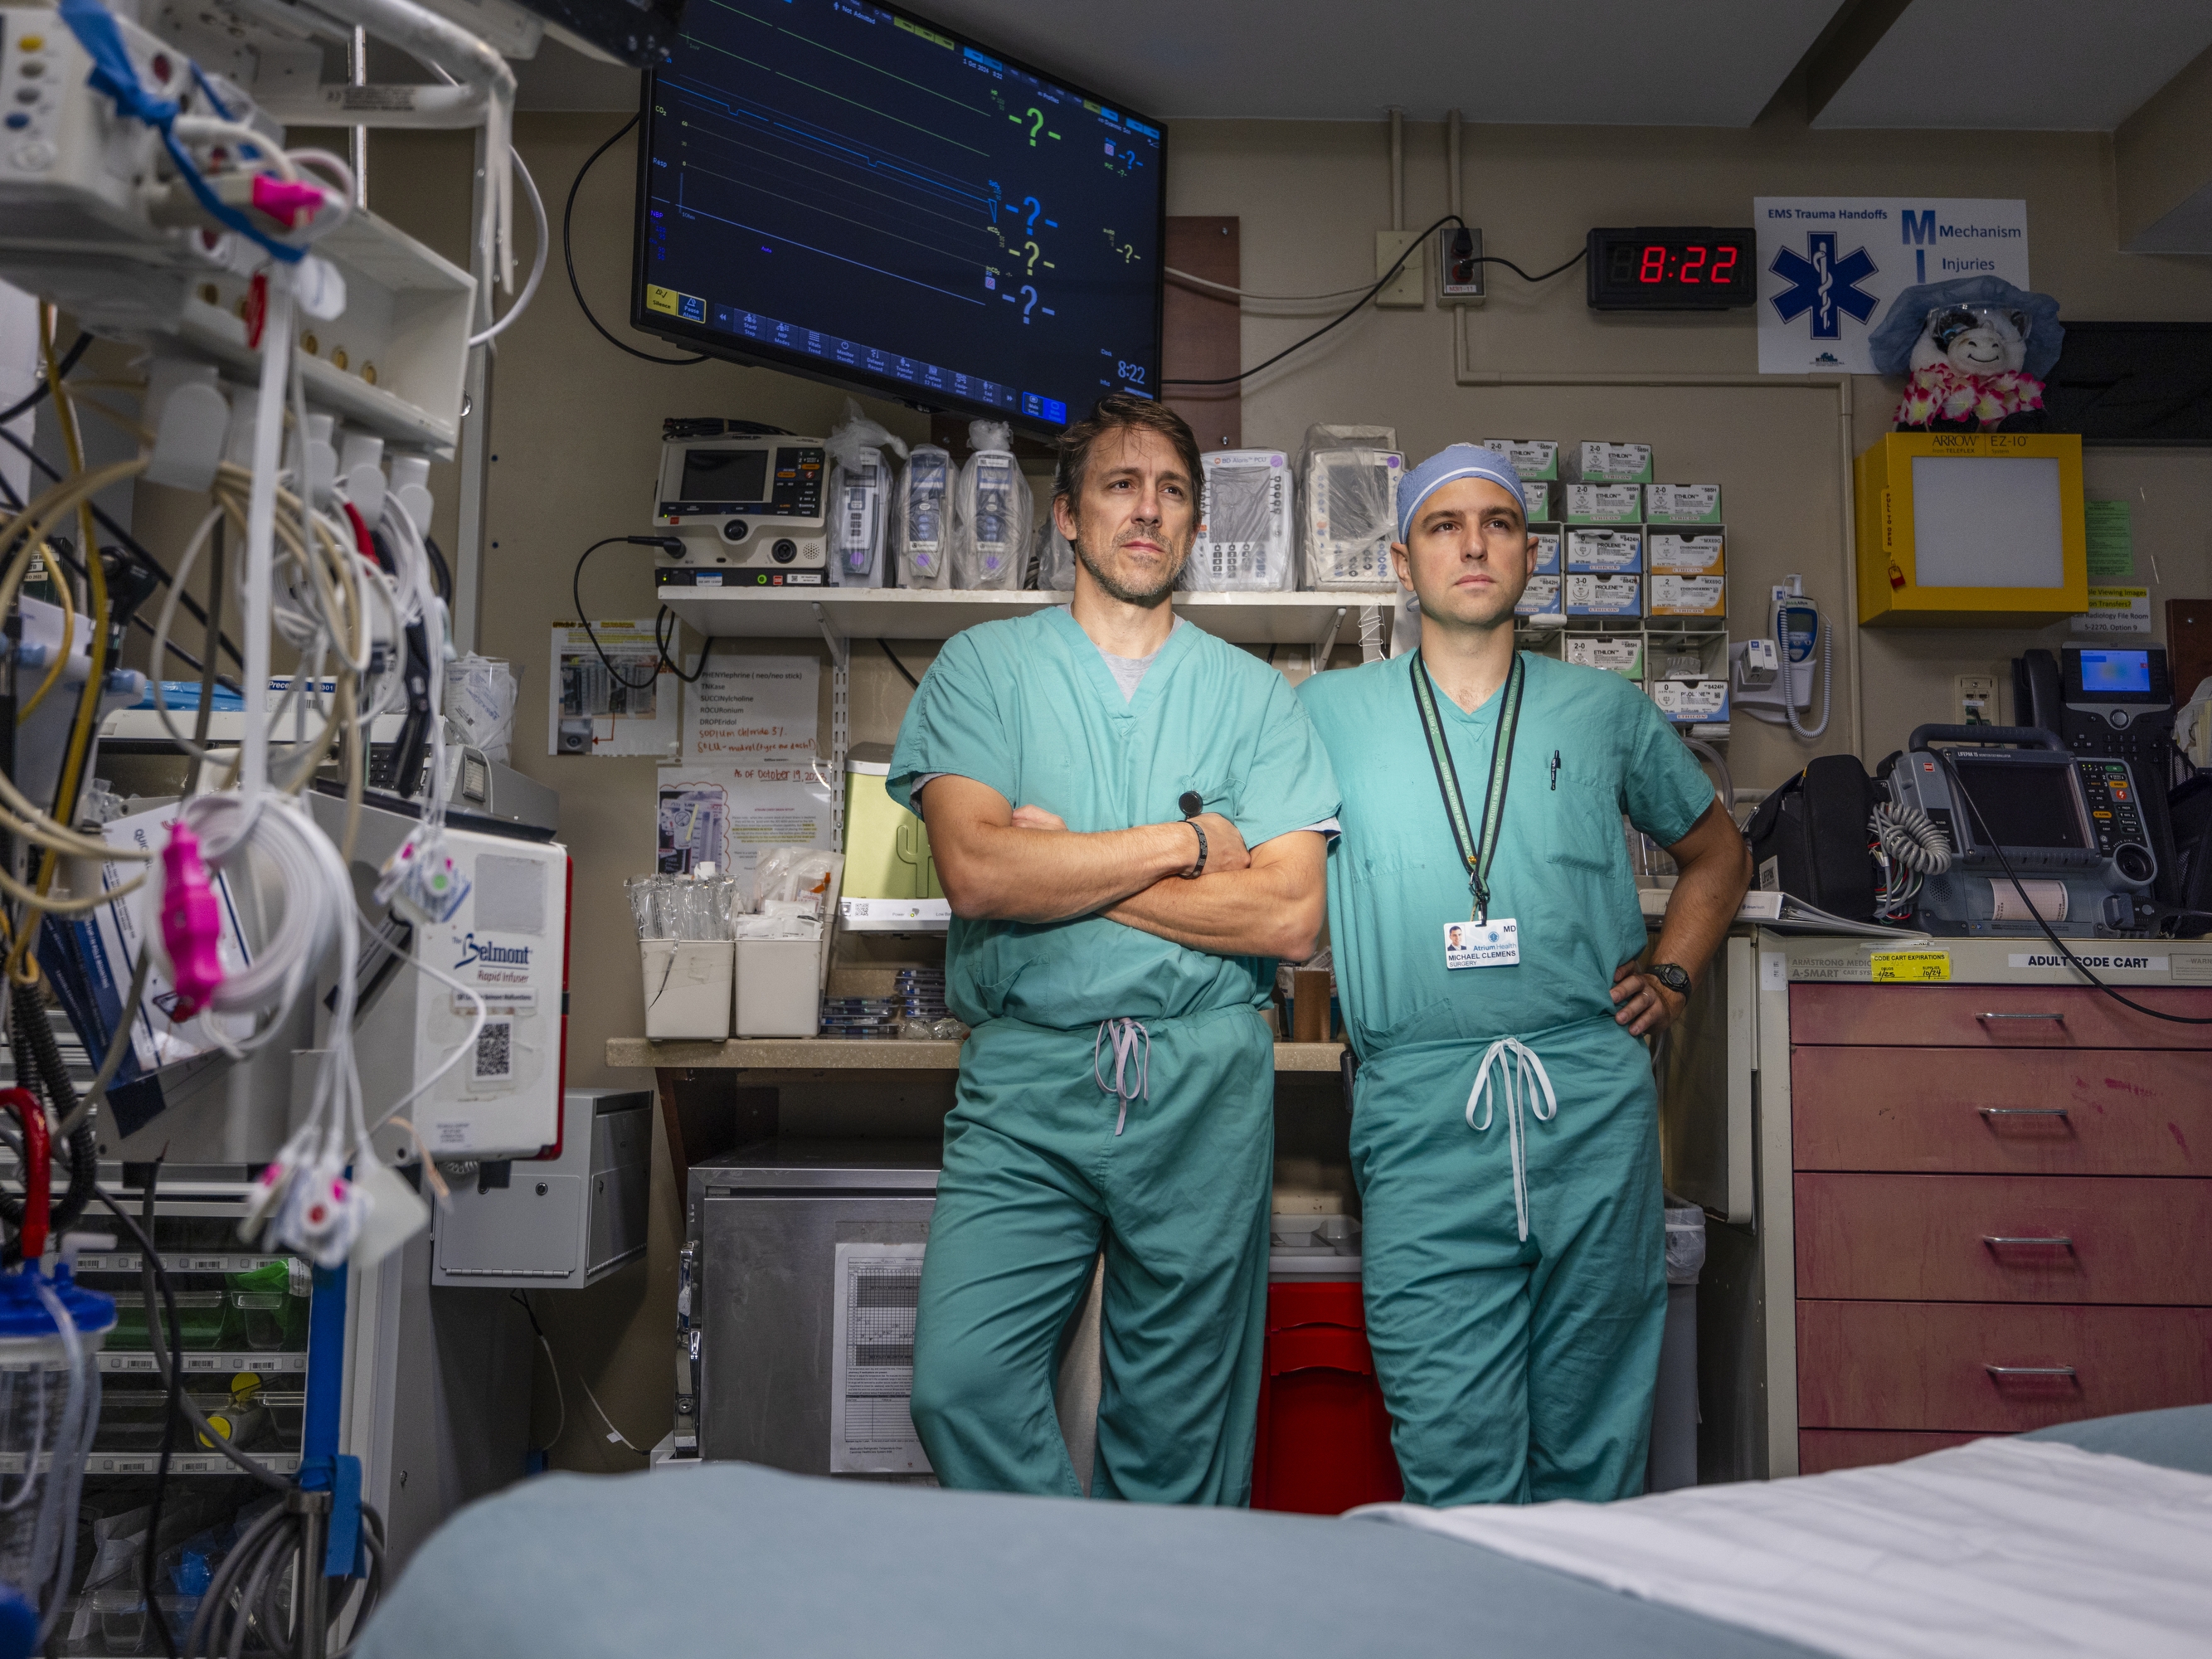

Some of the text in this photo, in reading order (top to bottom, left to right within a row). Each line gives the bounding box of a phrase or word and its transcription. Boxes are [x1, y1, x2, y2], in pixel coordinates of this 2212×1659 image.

[653, 158, 667, 168] Resp
[1767, 209, 1888, 221] EMS Trauma Handoffs
[1901, 209, 1937, 246] M
[1939, 224, 2021, 239] Mechanism
[1639, 246, 1738, 284] 8:22
[1942, 257, 1995, 272] Injuries
[653, 300, 671, 309] Silence
[837, 349, 854, 358] Monitor
[837, 356, 854, 365] Standby
[1118, 360, 1145, 385] 8:22
[2098, 589, 2123, 597] Viewing
[2124, 589, 2146, 597] Images
[2085, 612, 2116, 620] Radiology
[2110, 624, 2132, 632] Option
[702, 672, 750, 680] PHENYlephrine
[785, 672, 803, 680] stick)
[700, 695, 754, 703] SUCCINylcholine
[735, 768, 741, 778] As
[746, 768, 754, 778] of
[758, 769, 790, 780] October
[1492, 778, 1500, 800] SURGICAL
[1440, 761, 1450, 781] AUSTERE
[1456, 814, 1466, 836] SURGICAL
[1461, 836, 1470, 850] TEAM
[1762, 866, 1774, 884] LIFEPAK
[455, 932, 531, 970] Belmont
[1481, 951, 1516, 959] CLEMENS
[1792, 959, 1845, 967] ARMSTRONG
[2028, 956, 2148, 968] ADULT CODE CART
[95, 959, 110, 989] MOUNTING
[478, 971, 528, 984] Rapid Infuser
[1792, 969, 1839, 978] A-SMART
